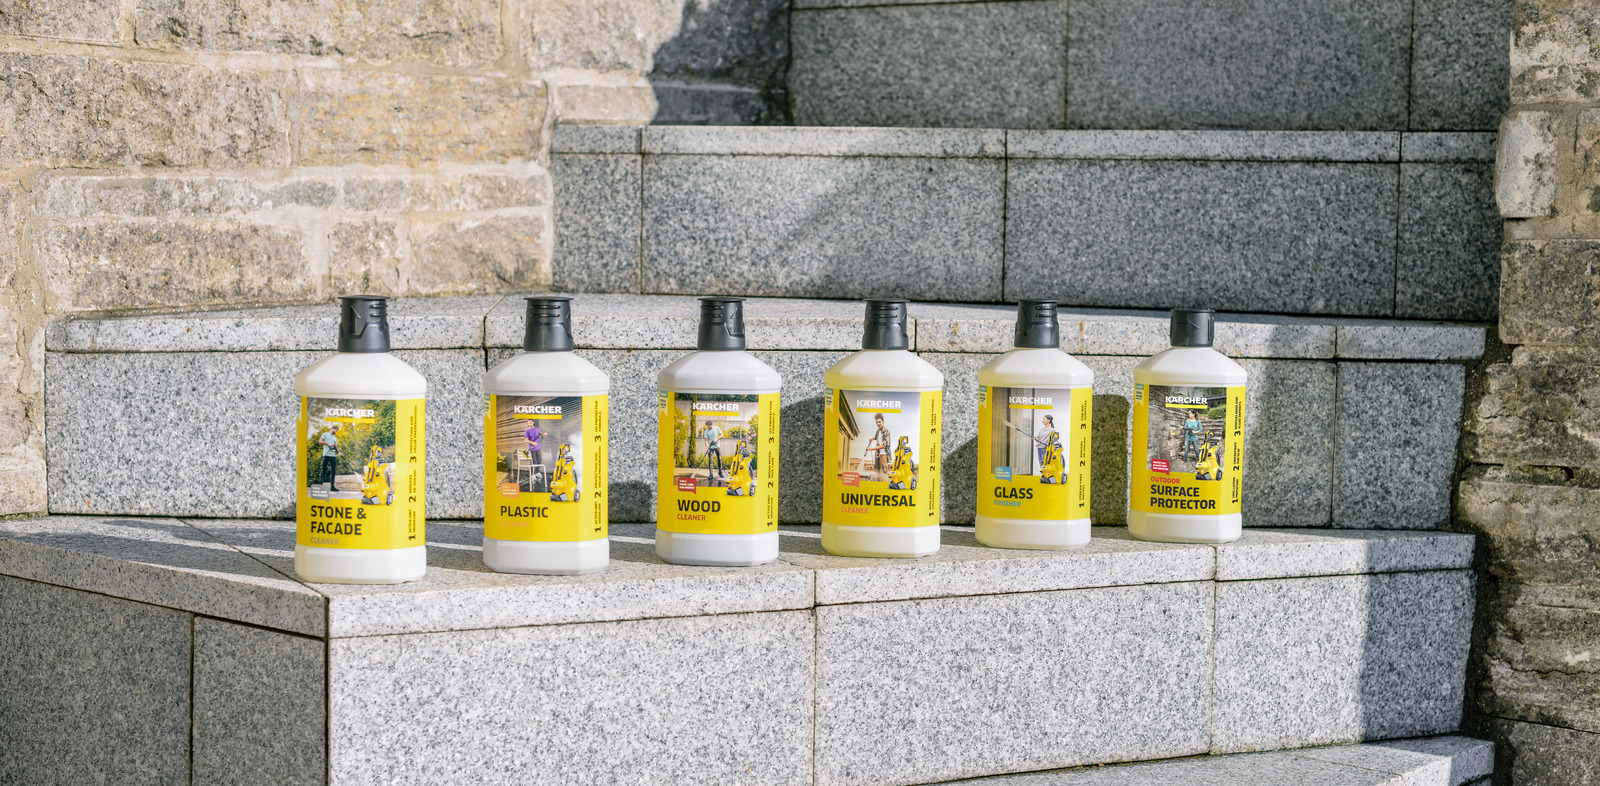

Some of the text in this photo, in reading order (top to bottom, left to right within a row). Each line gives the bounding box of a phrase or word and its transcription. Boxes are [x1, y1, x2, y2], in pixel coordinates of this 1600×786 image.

[325, 408, 375, 417] KÄRCHER
[514, 405, 562, 414] KÄRCHER
[994, 487, 1033, 499] GLASS
[1151, 485, 1199, 496] SURFACE
[678, 500, 720, 512] WOOD
[841, 493, 916, 507] UNIVERSAL
[1150, 498, 1215, 509] PROTECTOR
[311, 506, 366, 519] STONE &
[500, 506, 548, 518] PLASTIC
[311, 521, 362, 535] FACADE
